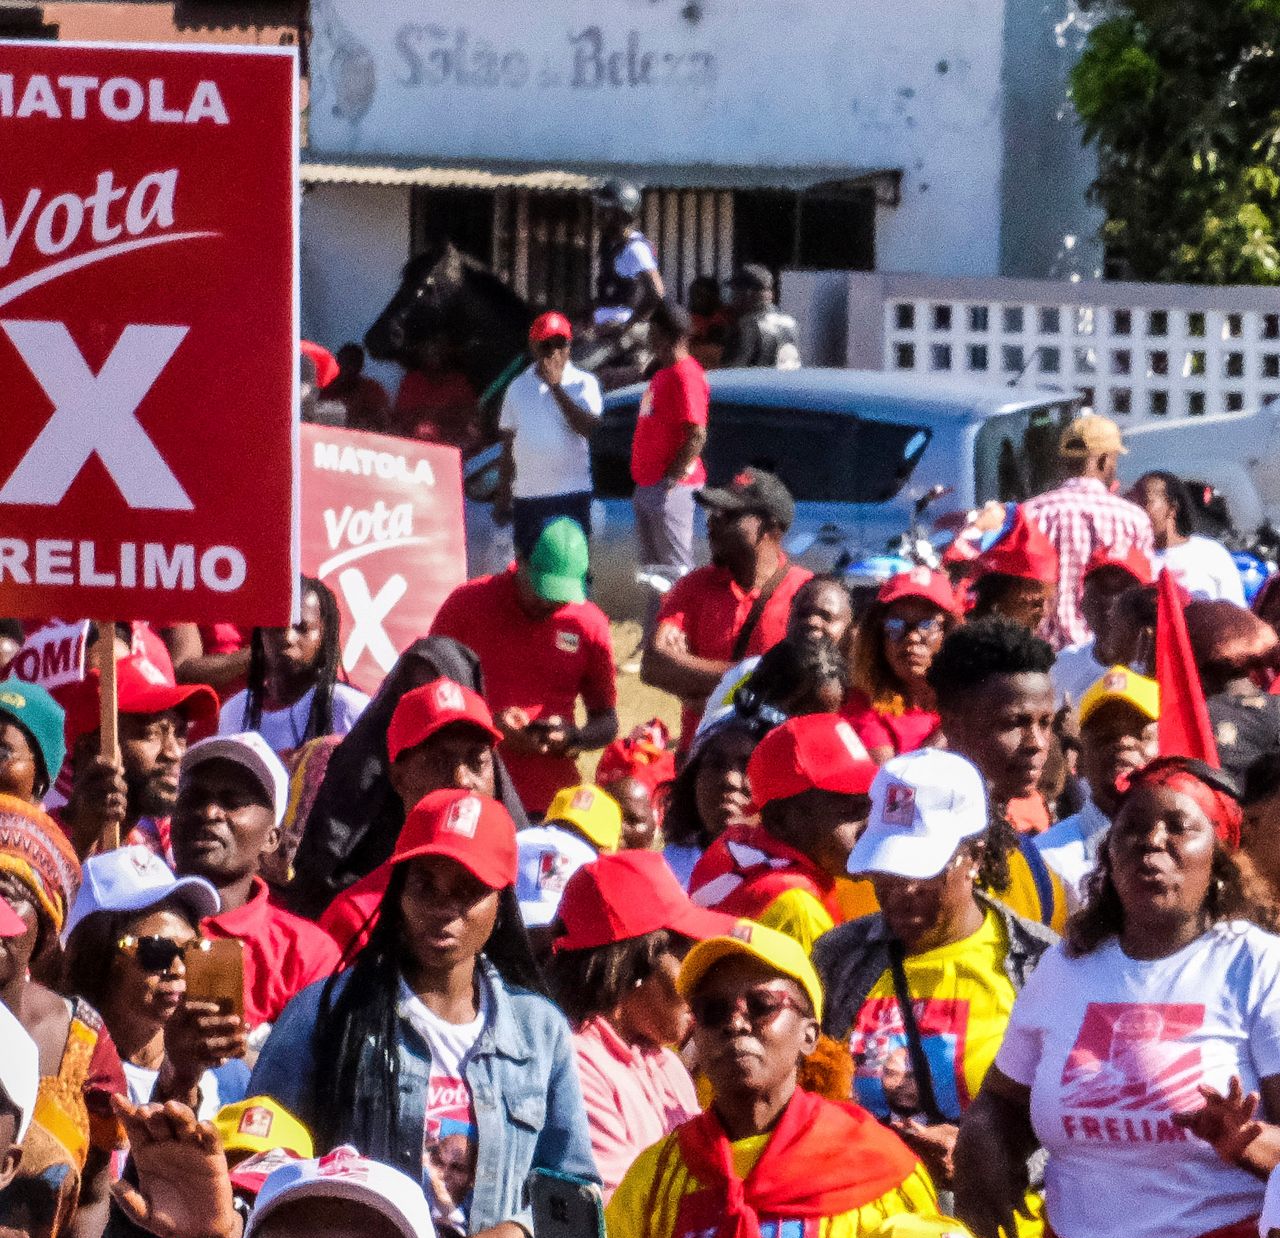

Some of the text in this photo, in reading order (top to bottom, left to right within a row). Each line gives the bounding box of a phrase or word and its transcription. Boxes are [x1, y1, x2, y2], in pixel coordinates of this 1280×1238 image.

[0, 319, 196, 511] X
[314, 441, 436, 487] MATOLA
[323, 500, 414, 550] Vota
[0, 537, 247, 593] RELIMO
[338, 567, 408, 673] X
[1062, 1114, 1188, 1143] FRELIM
